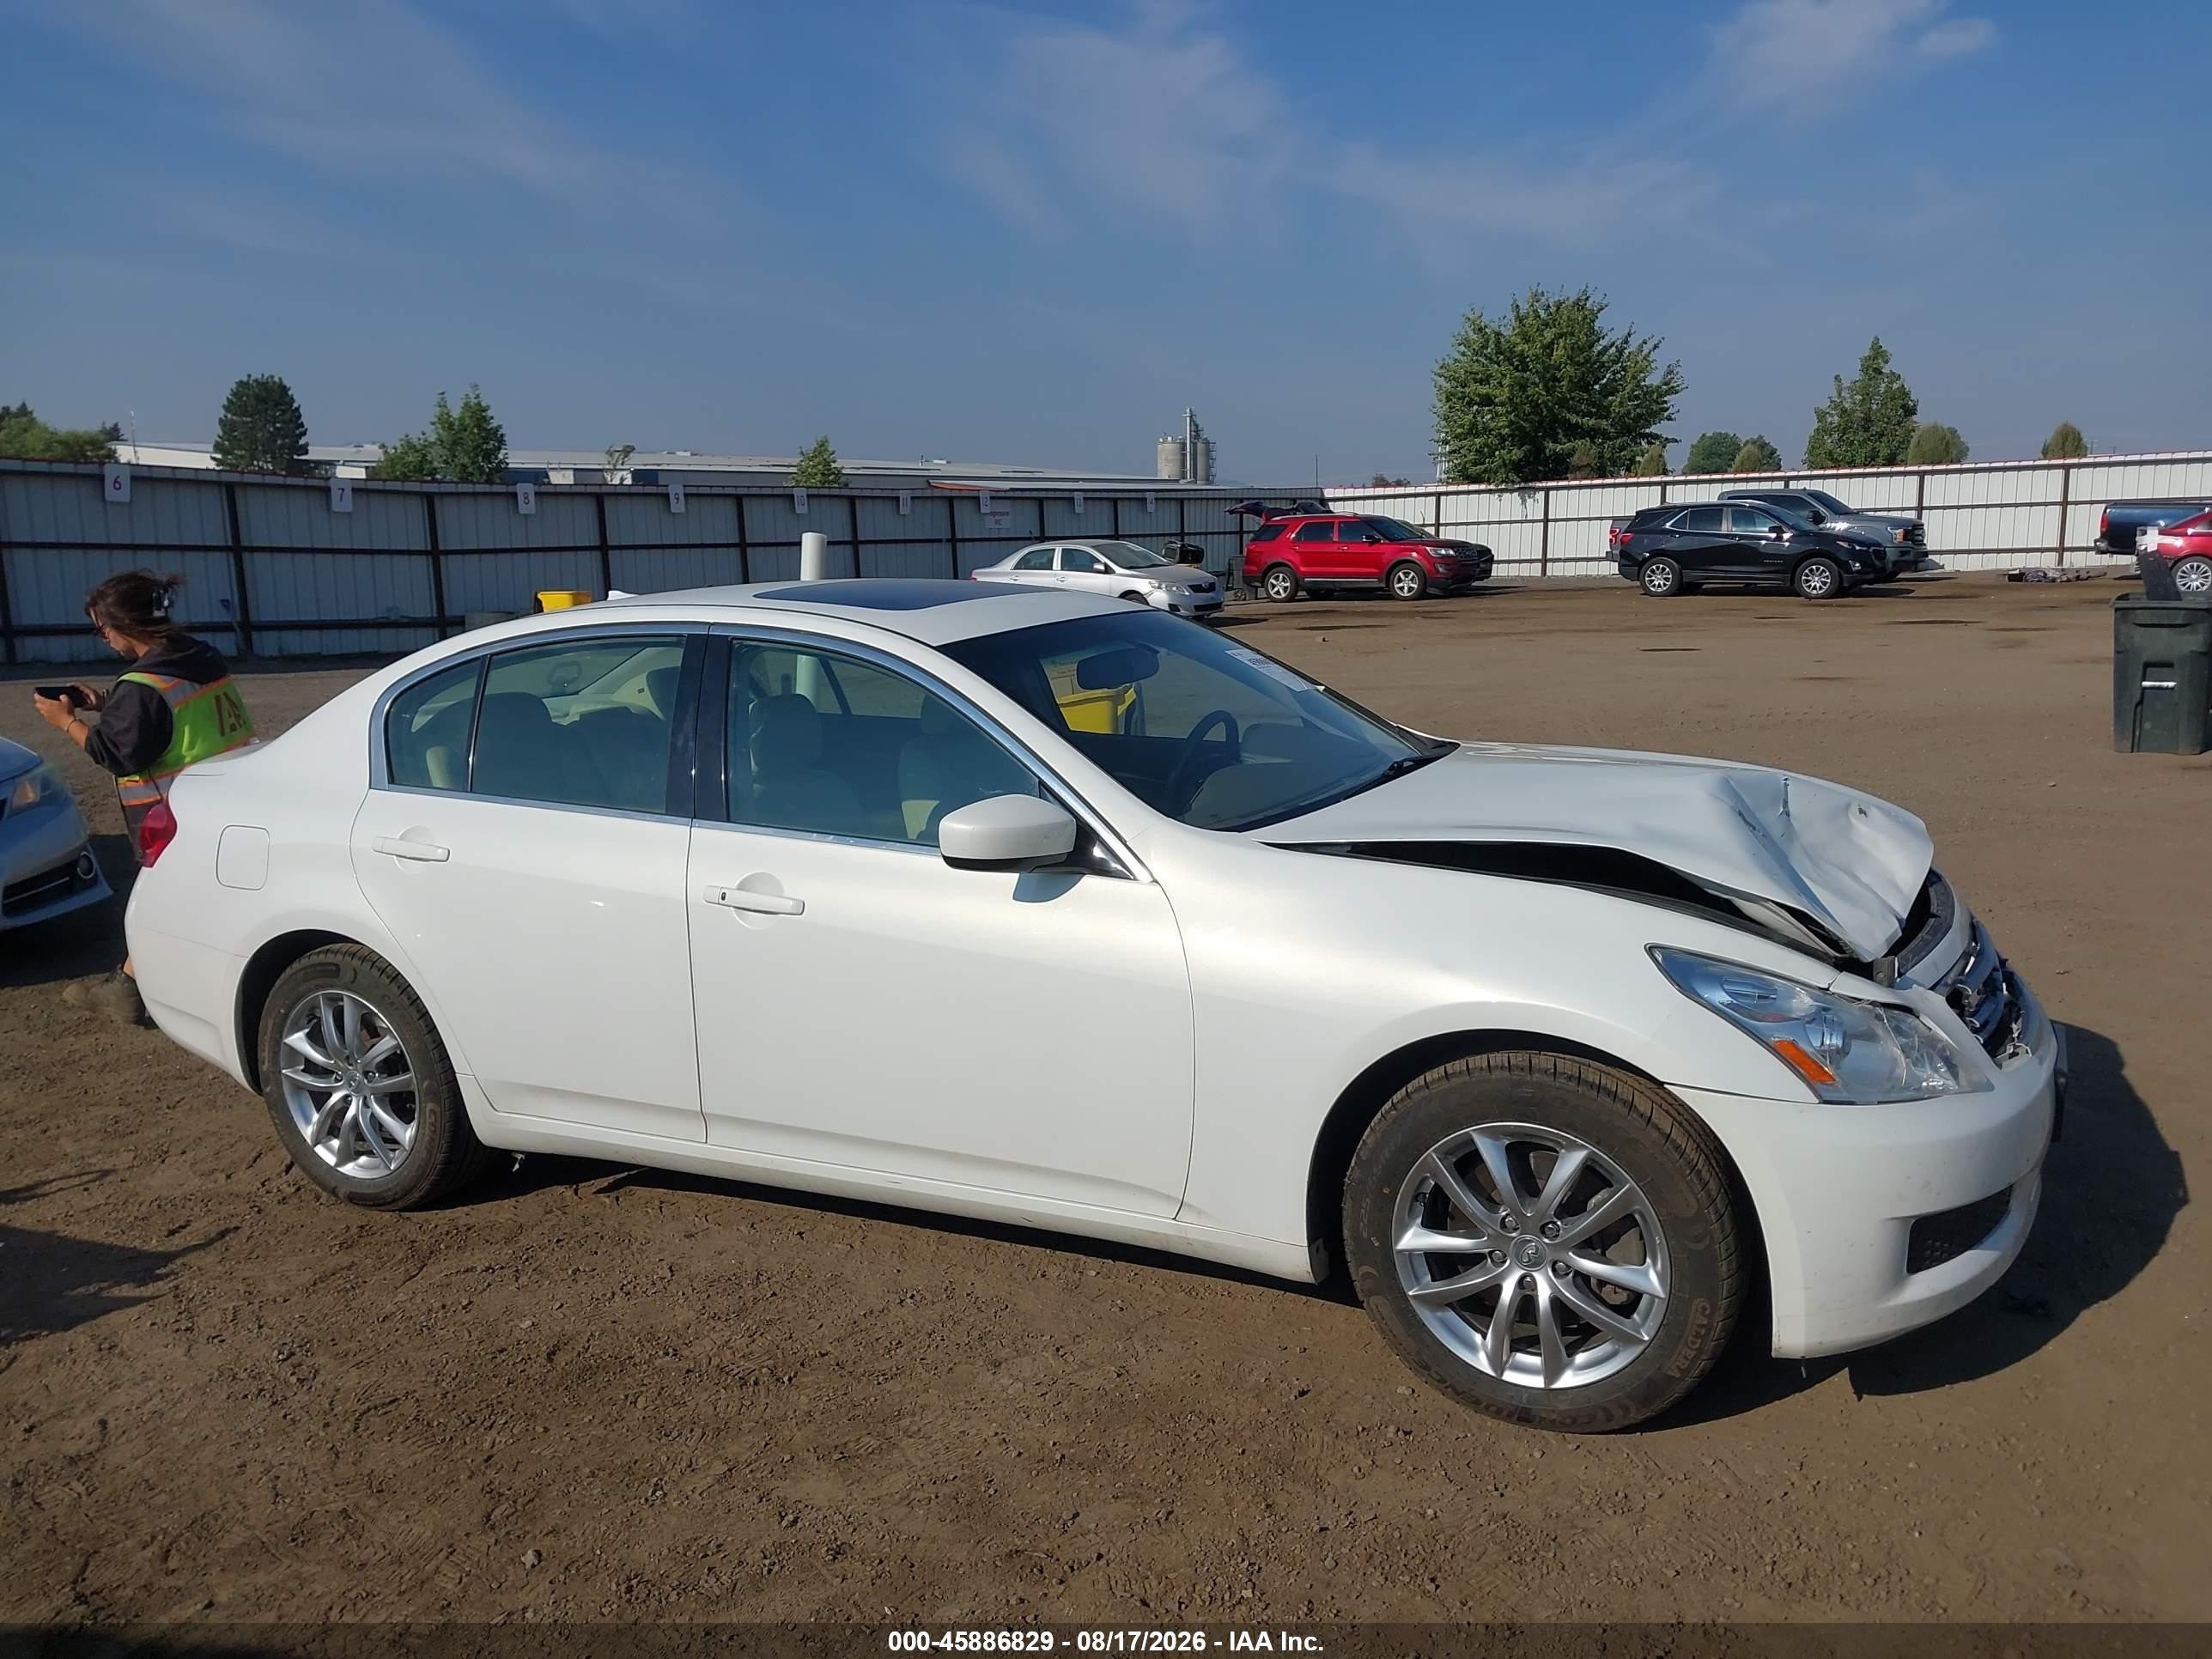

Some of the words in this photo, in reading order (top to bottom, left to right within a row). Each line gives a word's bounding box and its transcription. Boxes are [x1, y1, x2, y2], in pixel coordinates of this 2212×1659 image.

[113, 475, 122, 490] 6
[337, 487, 345, 502] 7
[523, 491, 530, 505] 8
[673, 492, 680, 505] 9
